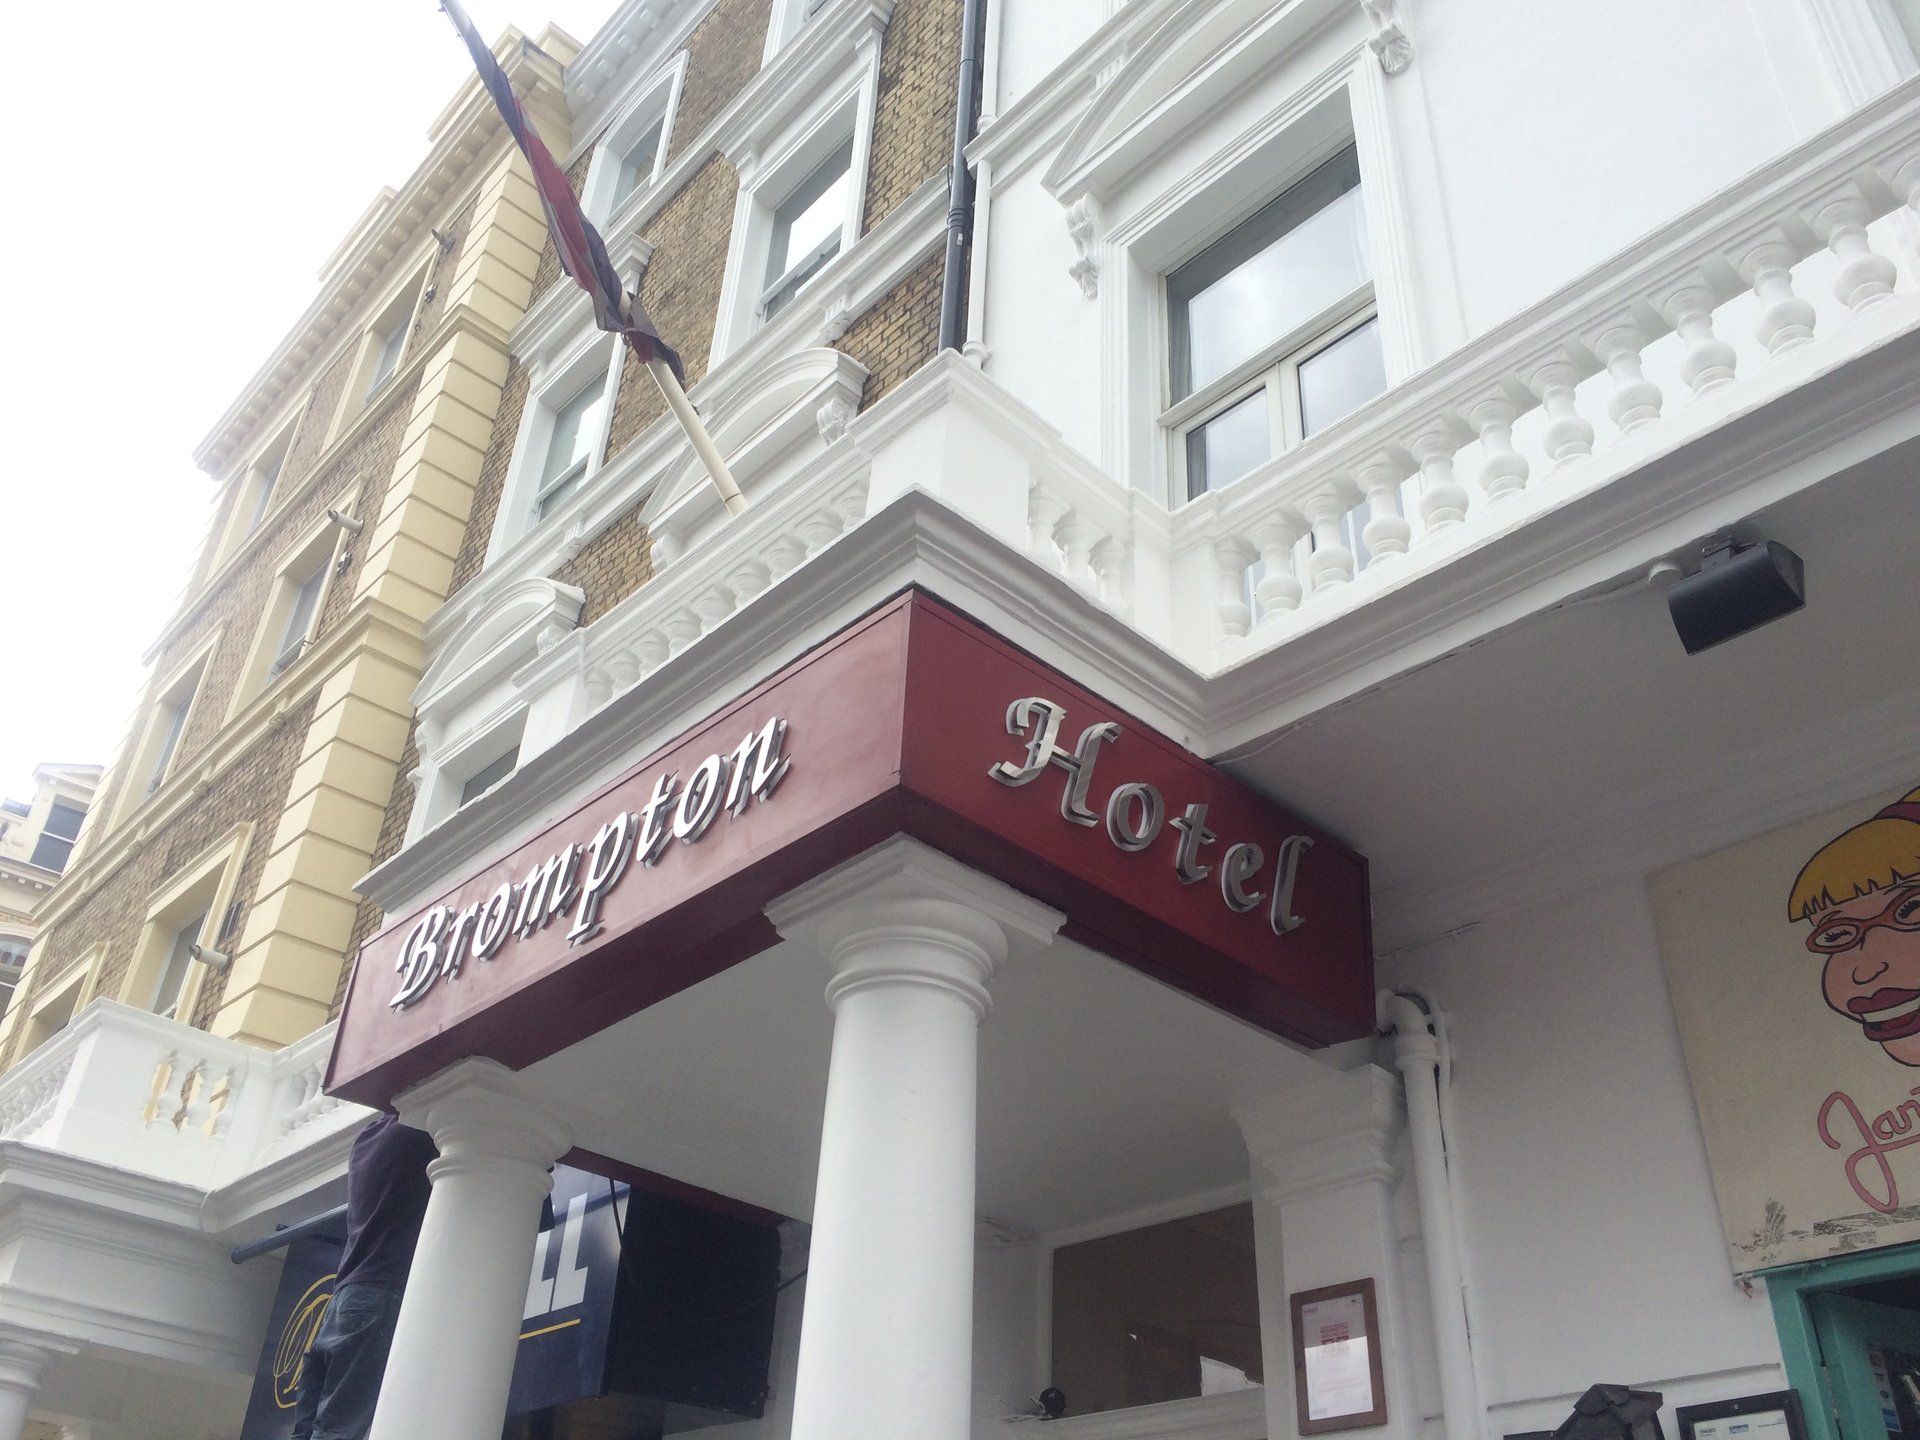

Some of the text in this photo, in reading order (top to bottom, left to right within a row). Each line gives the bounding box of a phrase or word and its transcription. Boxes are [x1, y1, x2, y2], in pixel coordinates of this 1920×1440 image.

[389, 697, 1314, 1014] Brompton Hotel
[1817, 1087, 1920, 1214] Jan
